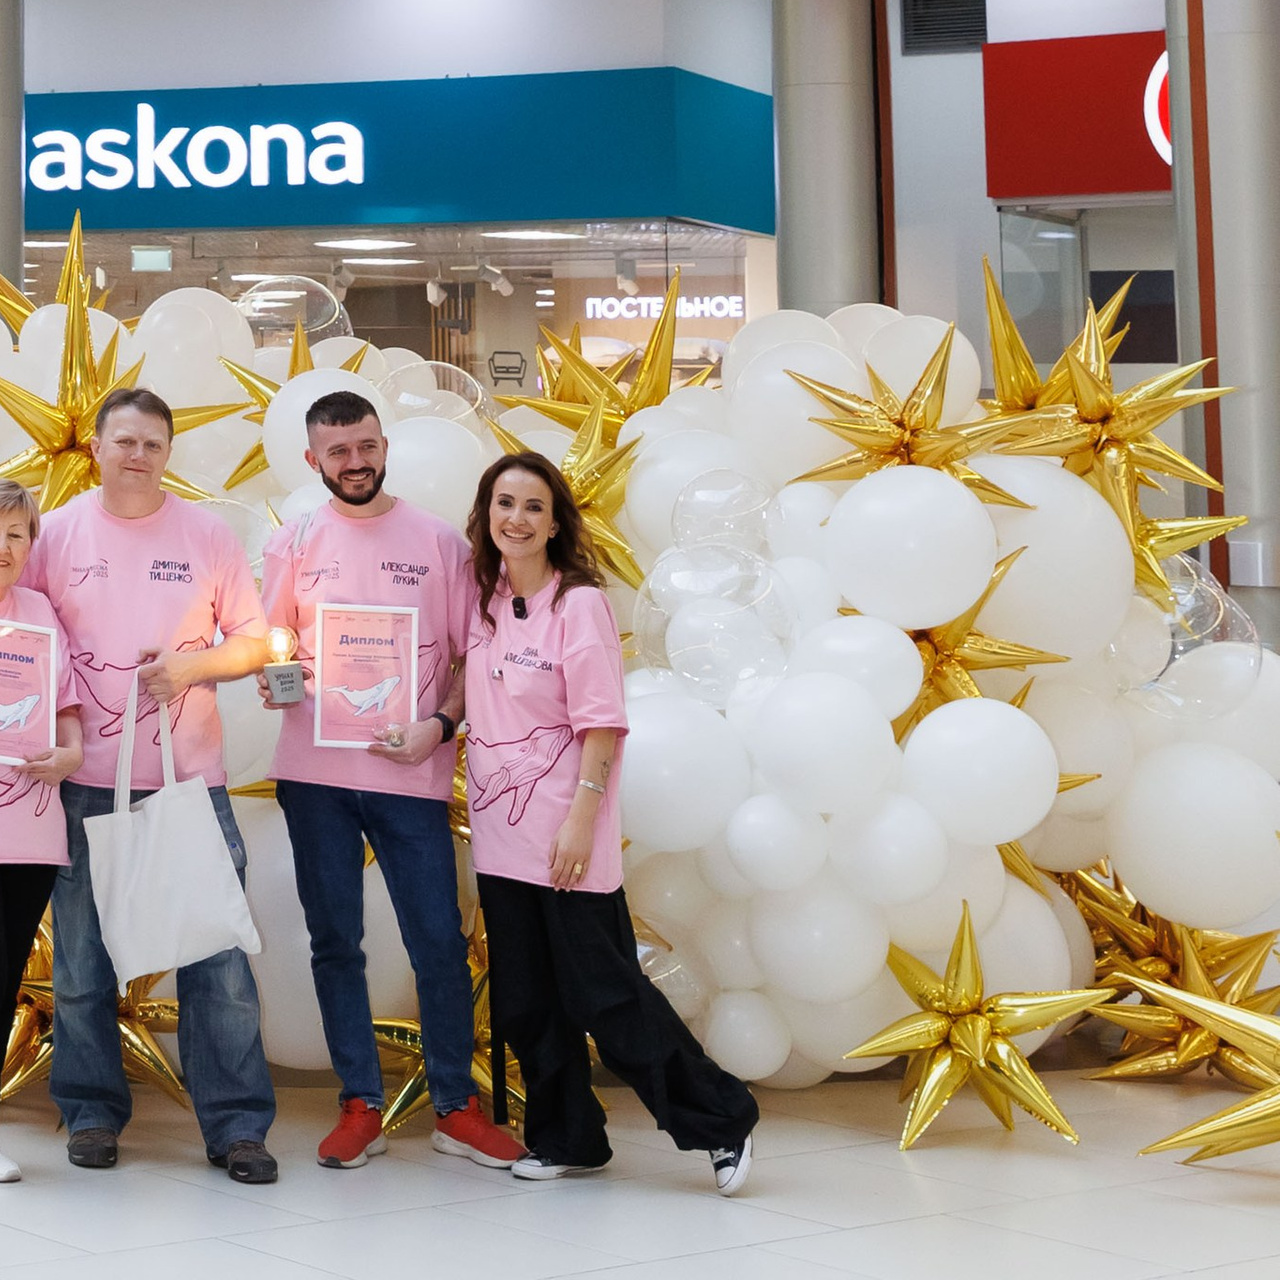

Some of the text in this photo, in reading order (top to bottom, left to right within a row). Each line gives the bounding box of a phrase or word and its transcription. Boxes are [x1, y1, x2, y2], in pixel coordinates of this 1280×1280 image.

[28, 102, 365, 192] askona
[151, 559, 190, 572] ДМИТРИЙ
[380, 561, 430, 576] АЛЕКСАНДР
[149, 571, 193, 584] ТИЩЕНКО
[392, 574, 419, 586] ЛУКИН
[339, 634, 395, 646] Диплом
